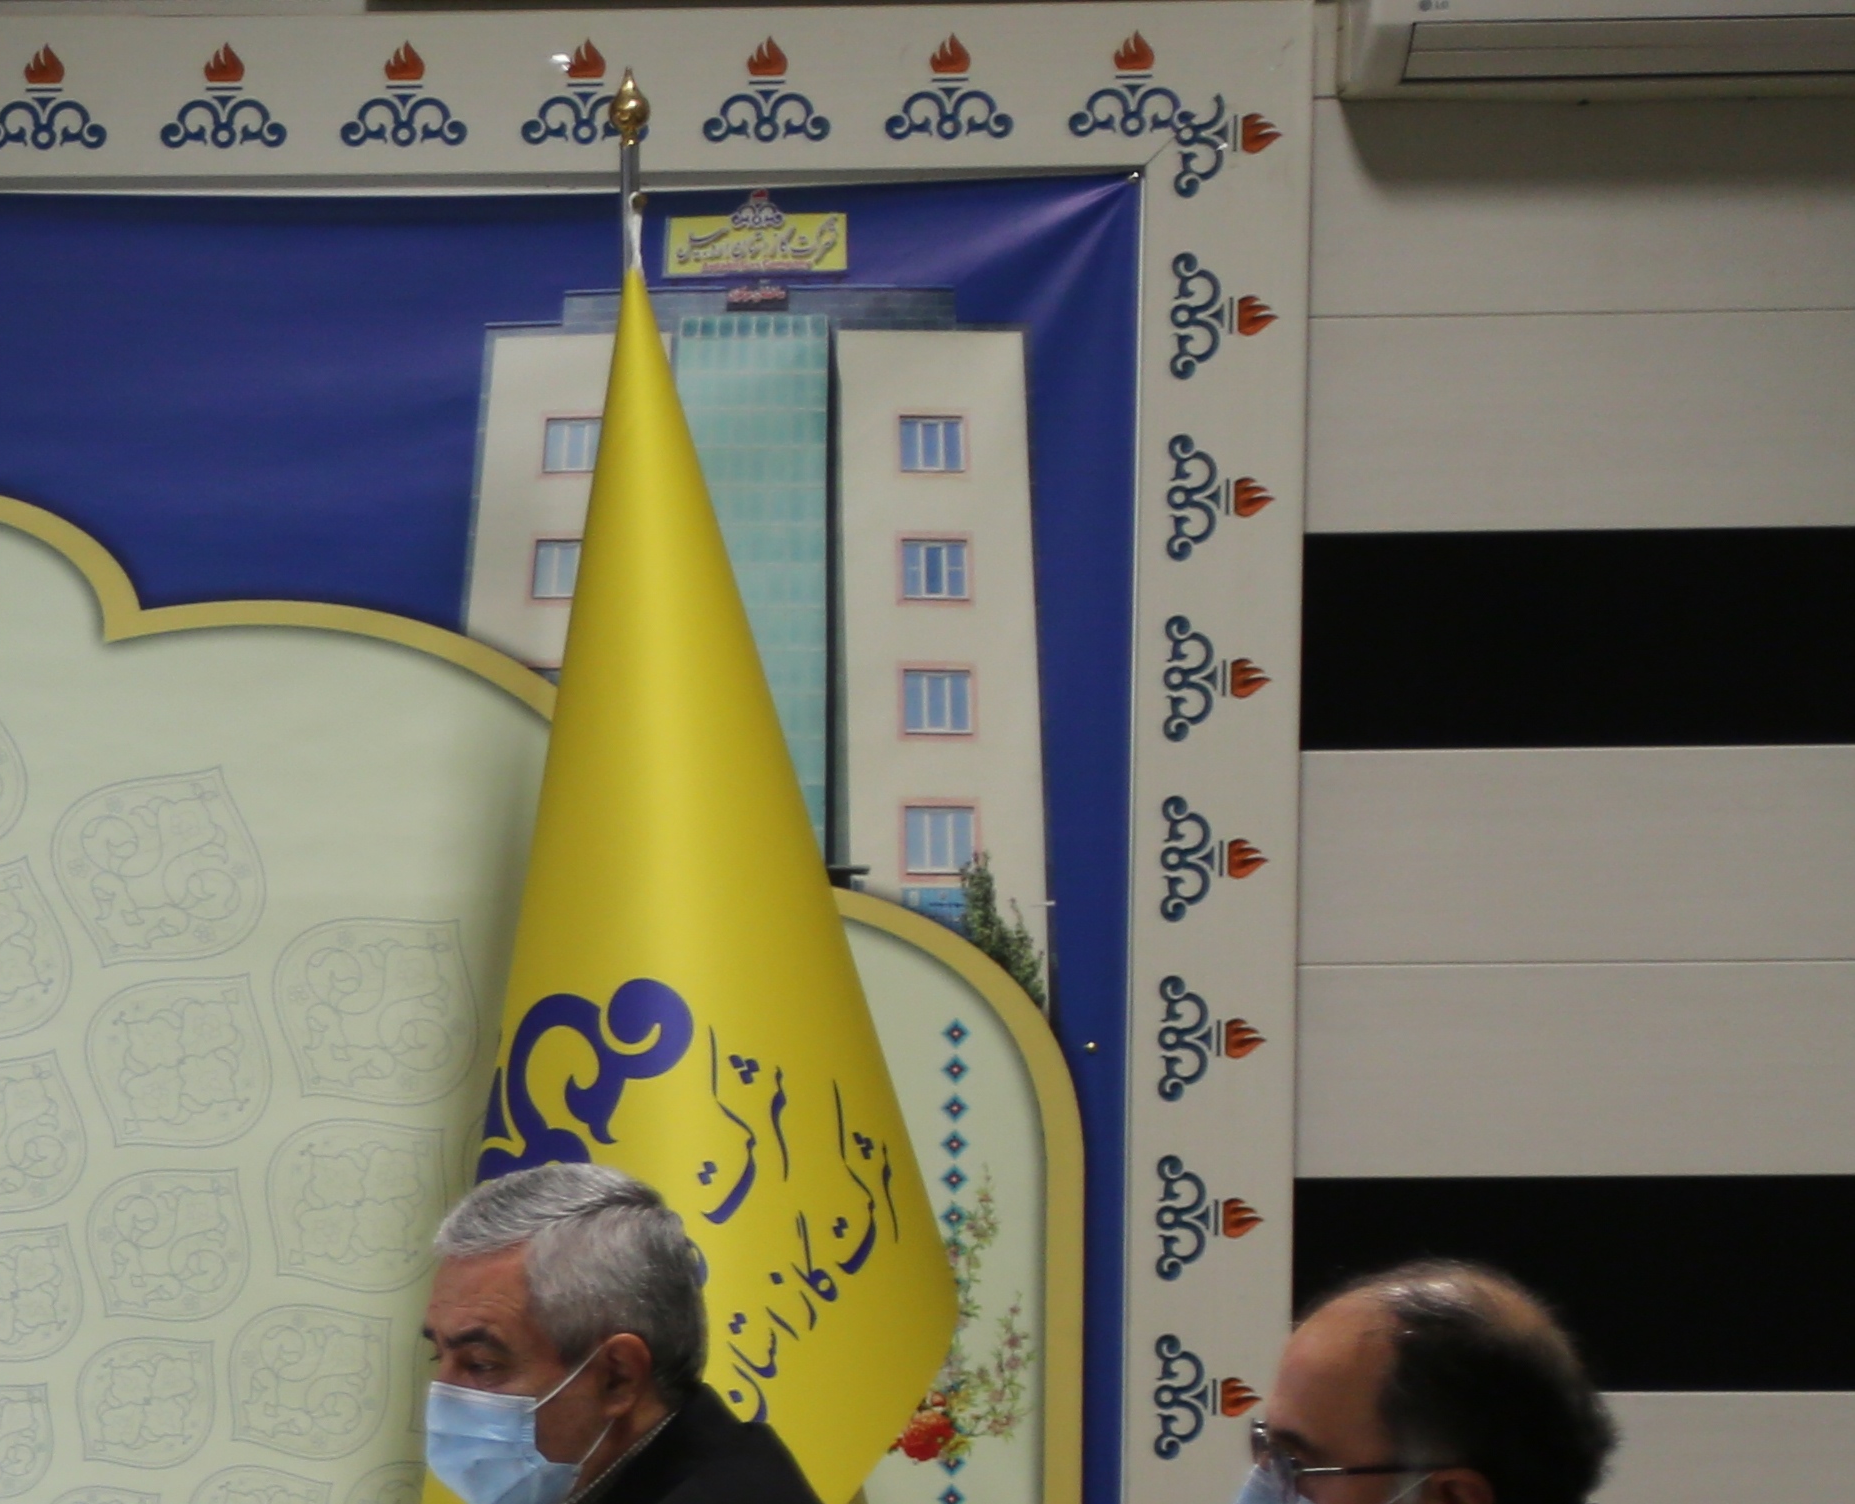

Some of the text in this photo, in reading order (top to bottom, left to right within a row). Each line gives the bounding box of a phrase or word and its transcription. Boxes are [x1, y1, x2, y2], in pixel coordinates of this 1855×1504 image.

[697, 1024, 789, 1226] شرکت
[832, 1078, 899, 1276] شرکت
[770, 1210, 839, 1332] گاز
